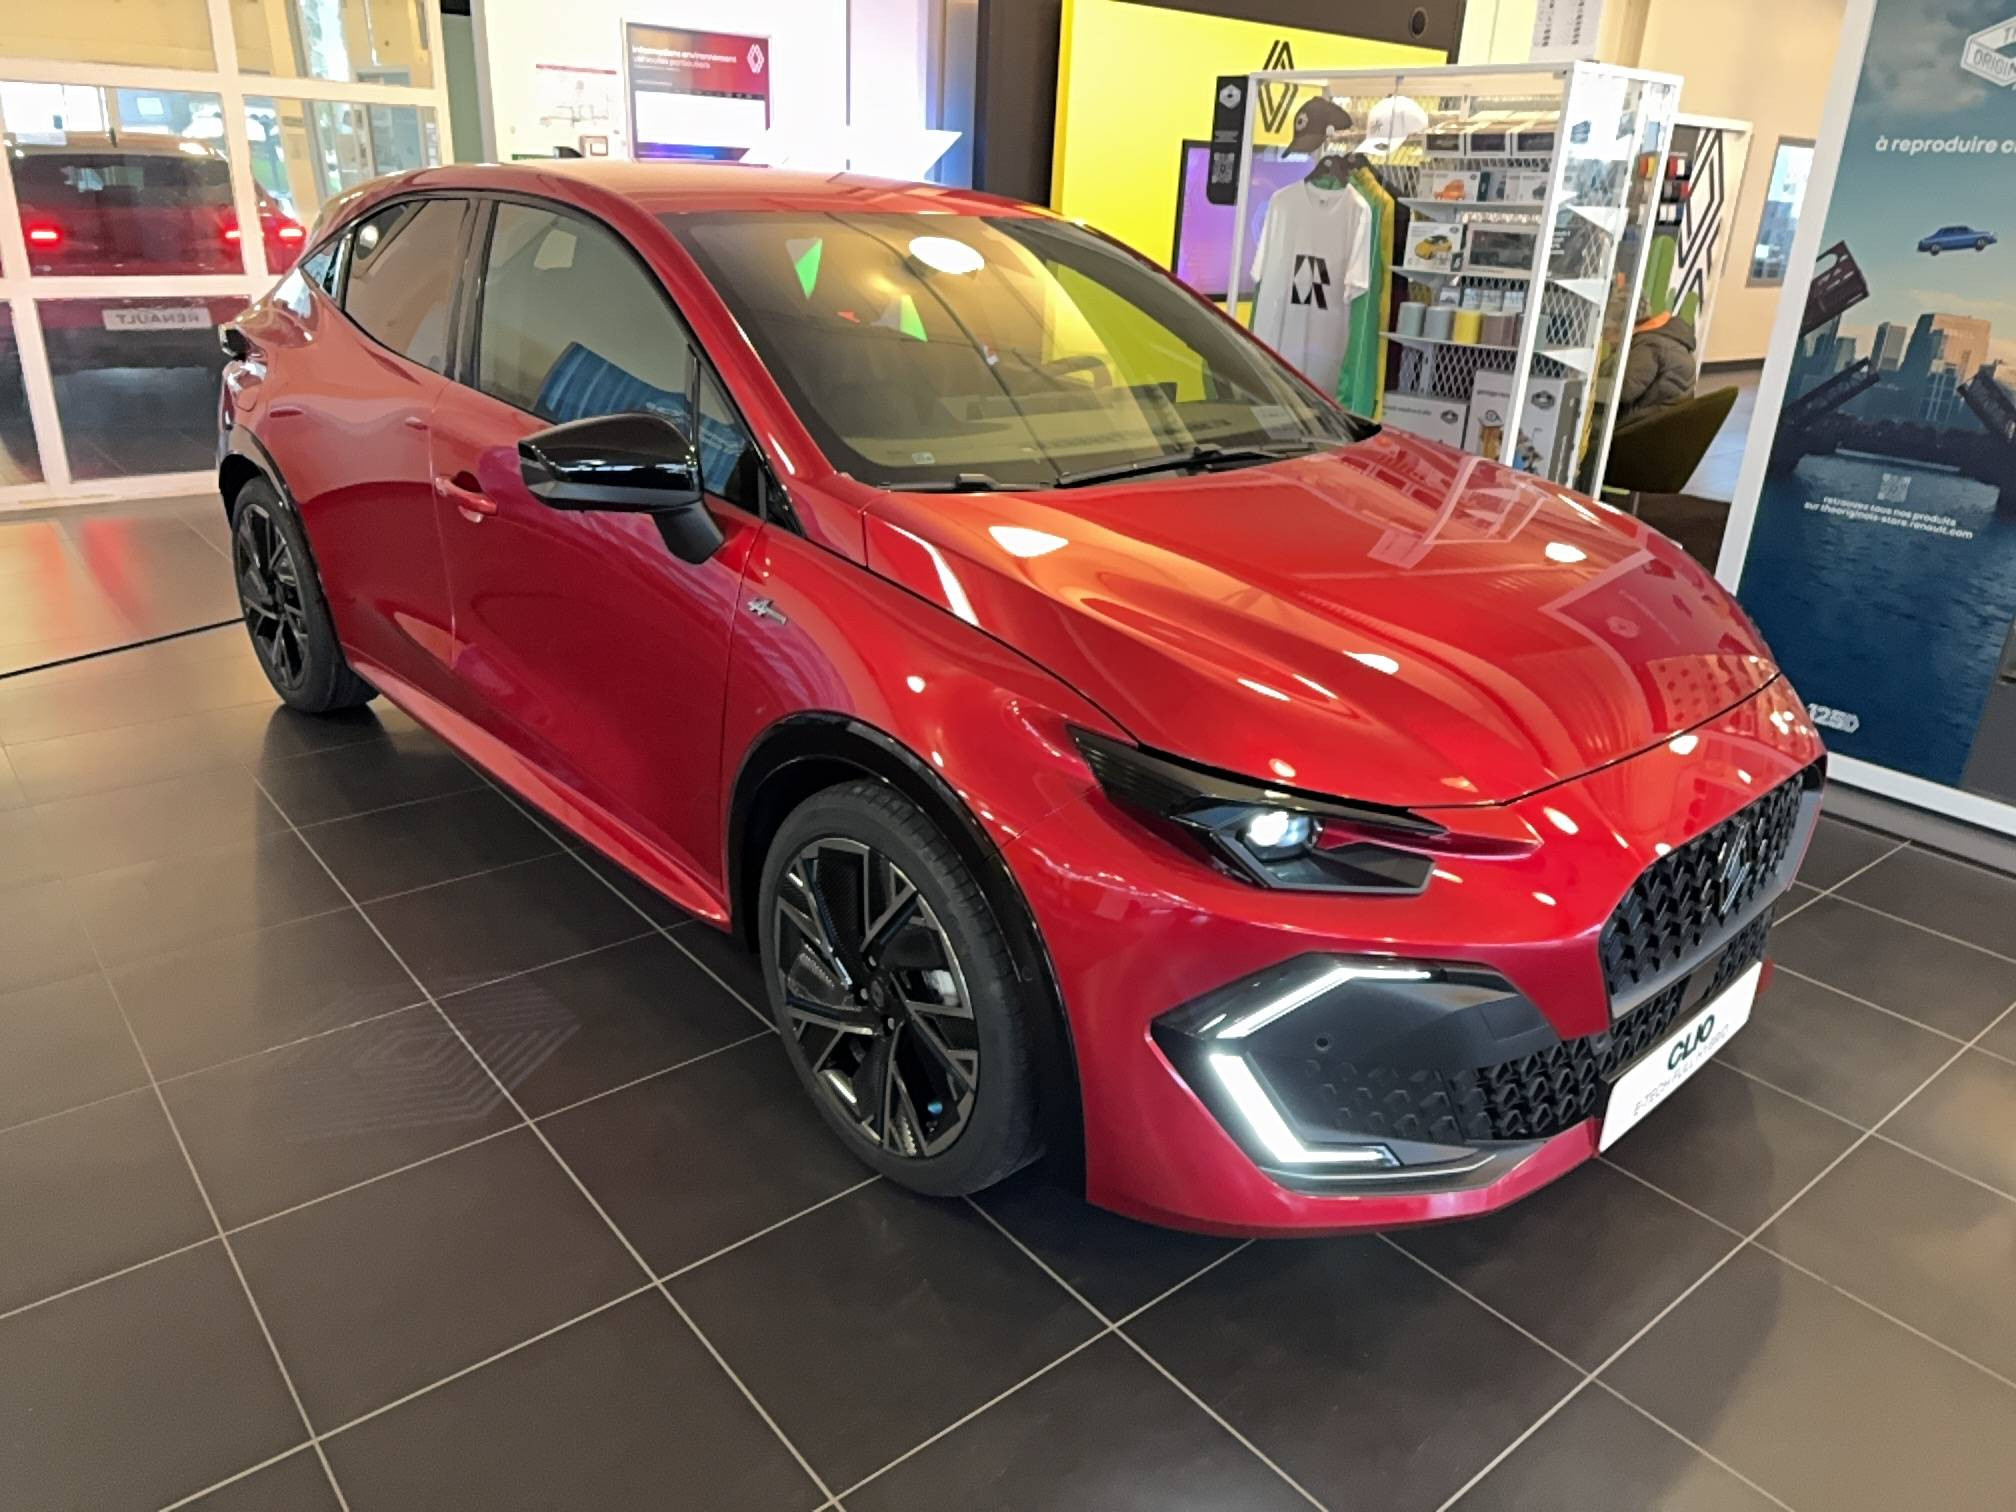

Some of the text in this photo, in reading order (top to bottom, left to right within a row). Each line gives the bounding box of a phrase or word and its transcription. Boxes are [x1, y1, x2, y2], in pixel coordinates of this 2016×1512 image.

[1875, 135, 2016, 156] à reproduire c
[1870, 504, 1893, 515] tous
[1894, 508, 1912, 518] nos
[1912, 511, 1957, 527] produits
[1667, 1014, 1715, 1070] CLIO
